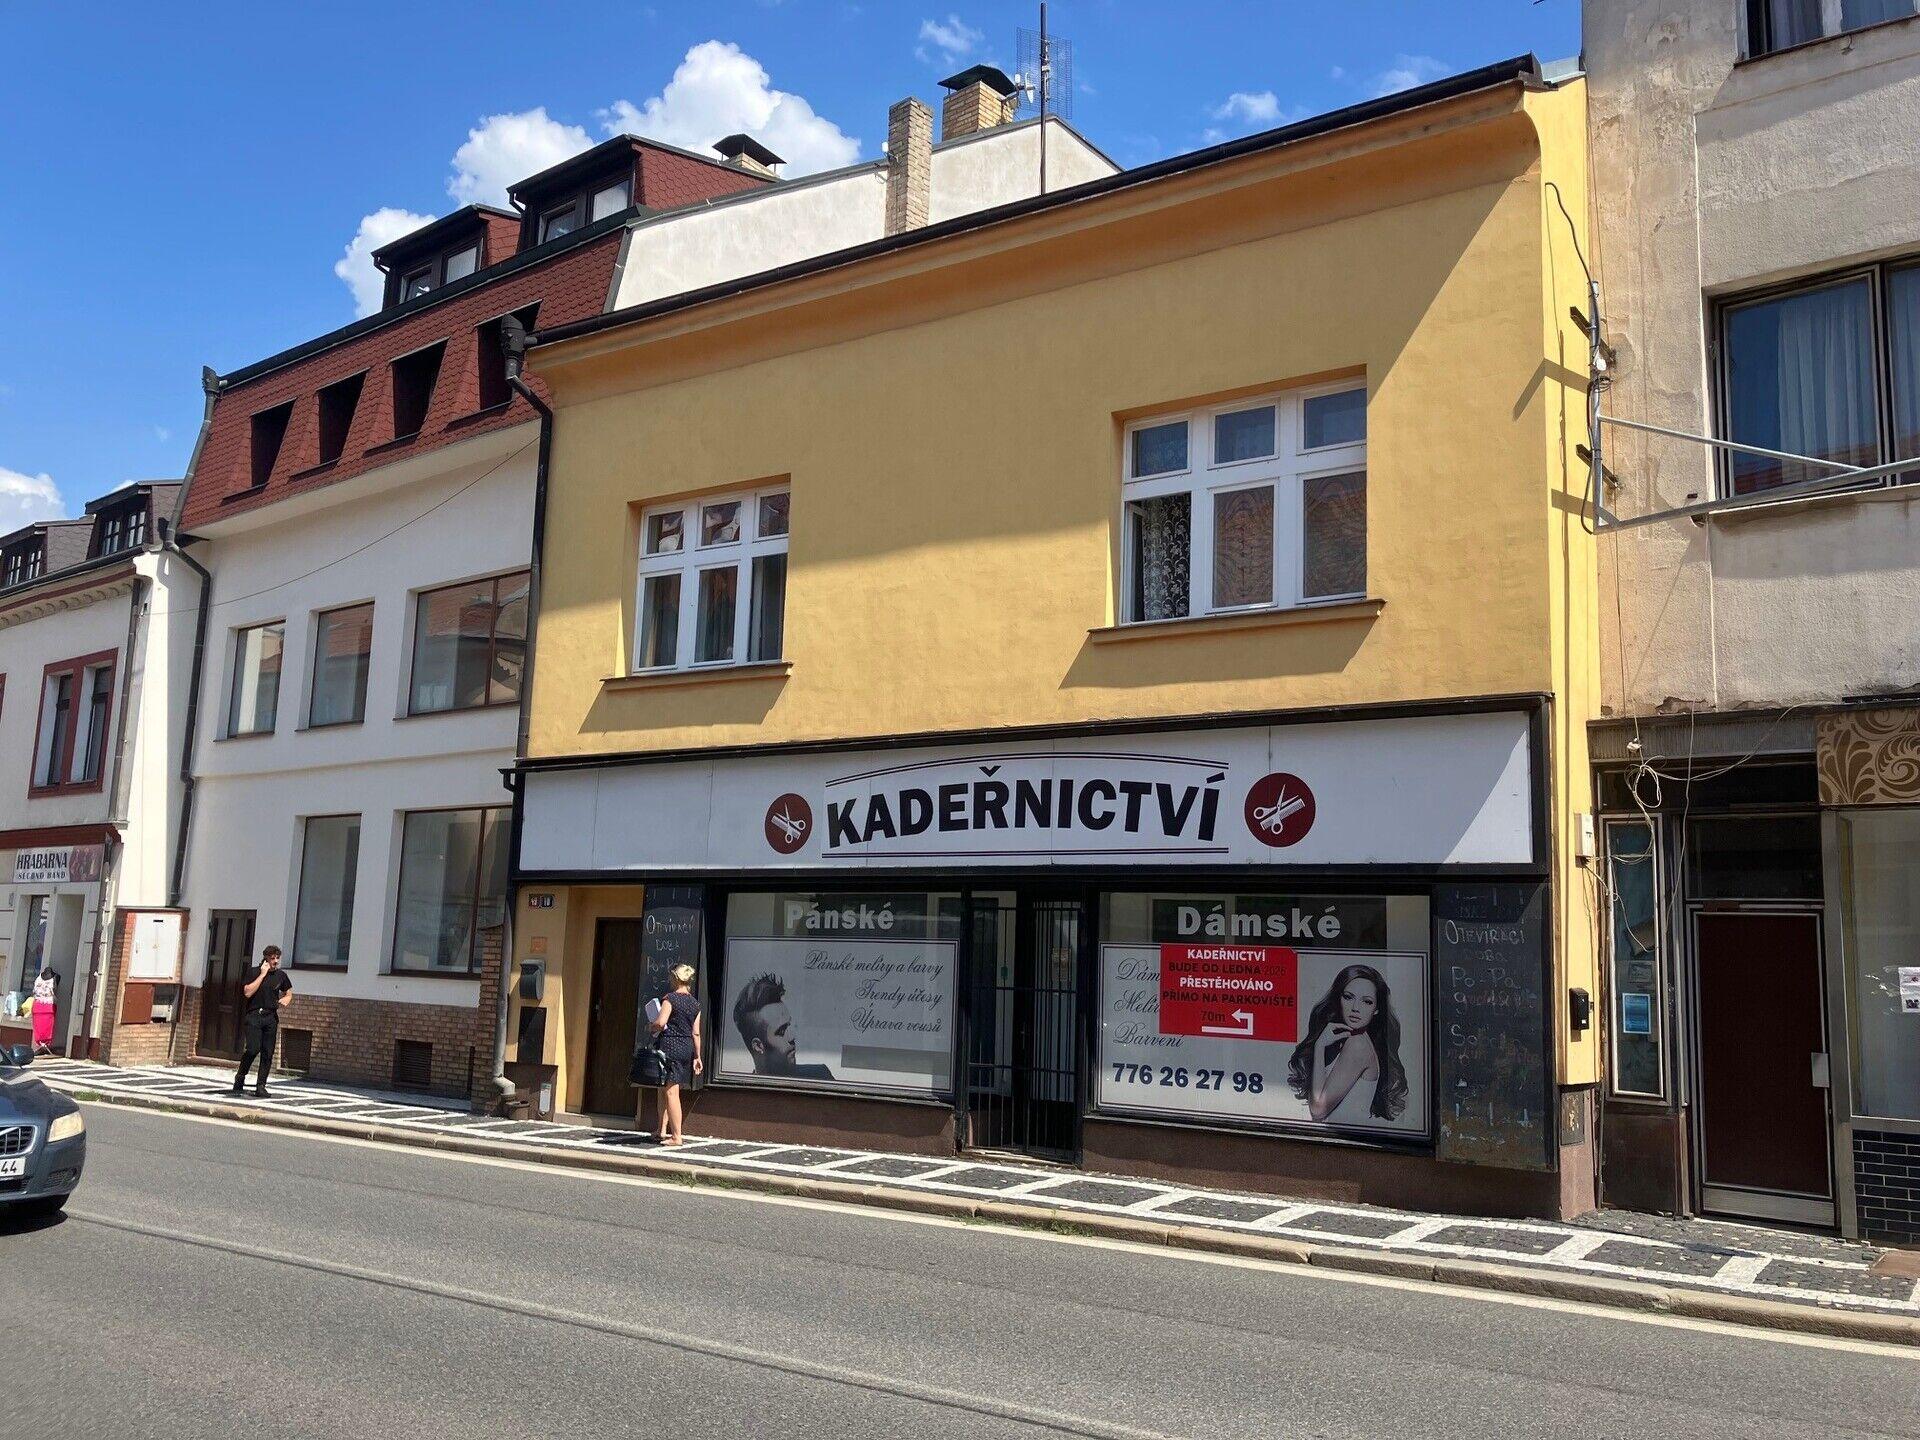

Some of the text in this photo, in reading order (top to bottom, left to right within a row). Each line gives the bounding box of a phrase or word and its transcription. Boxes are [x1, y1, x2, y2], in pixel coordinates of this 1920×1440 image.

[827, 765, 1226, 848] KADEŘNICTVÍ
[18, 872, 45, 880] SECOND
[784, 902, 894, 930] Pánské
[1178, 904, 1341, 939] Dámské
[803, 950, 944, 982] Pánské melíry a barvy
[1187, 947, 1267, 962] KADEŘNICTVÍ
[1168, 962, 1199, 973] BUDE
[1202, 963, 1219, 974] OD
[1222, 964, 1262, 976] LEDNA
[855, 979, 944, 1011] Trendy účesy
[1179, 975, 1274, 992] PŘESTĚHOVÁNO
[1202, 992, 1218, 1003] NA
[850, 1002, 943, 1036] Úprava vousů
[1201, 1010, 1226, 1023] 70m
[1113, 1021, 1185, 1048] Barvení
[1112, 1062, 1264, 1094] 776 26 27 98
[1, 1160, 18, 1174] 44
